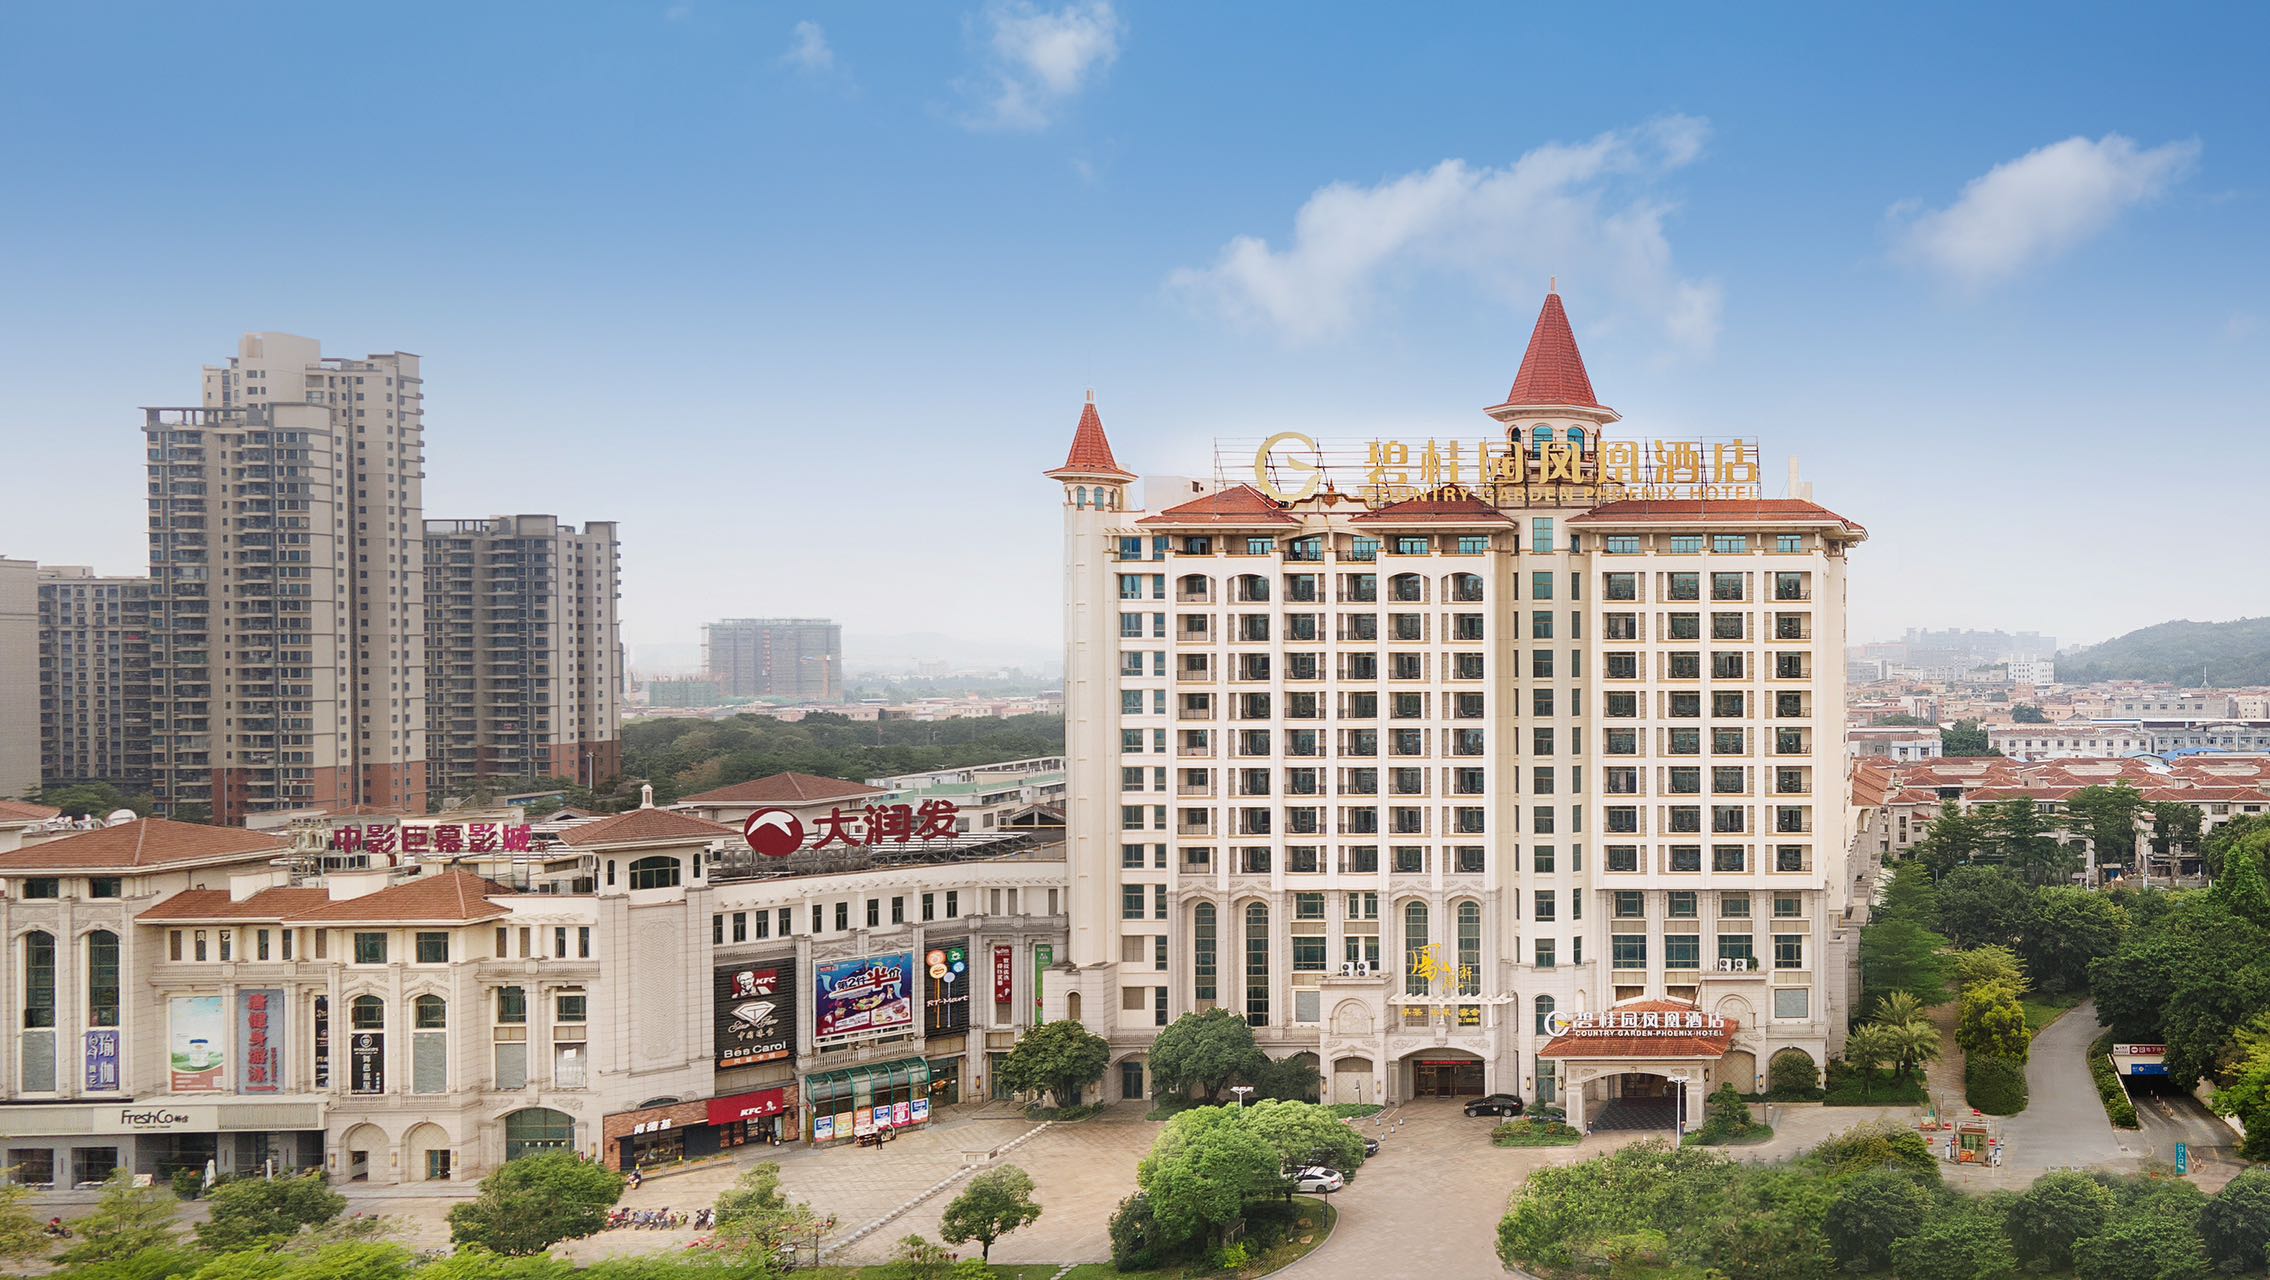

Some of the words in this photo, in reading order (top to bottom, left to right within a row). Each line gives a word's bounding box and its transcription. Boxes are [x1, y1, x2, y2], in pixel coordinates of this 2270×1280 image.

[1364, 439, 1758, 484] 碧桂园凤凰酒店
[1366, 486, 1470, 502] COUNTRY
[1484, 486, 1574, 501] GARDEN
[1583, 486, 1677, 501] PHOENIX
[1690, 486, 1760, 500] HOTEL
[811, 800, 960, 849] 大润发
[334, 823, 533, 853] 中影巨幕影城
[755, 976, 776, 985] KFC
[927, 995, 969, 1007] RT-Mart
[1574, 1011, 1724, 1029] 碧桂园凤凰酒店
[752, 1041, 787, 1053] Carol
[121, 1109, 174, 1124] FreshCo
[740, 1107, 762, 1116] KFC
